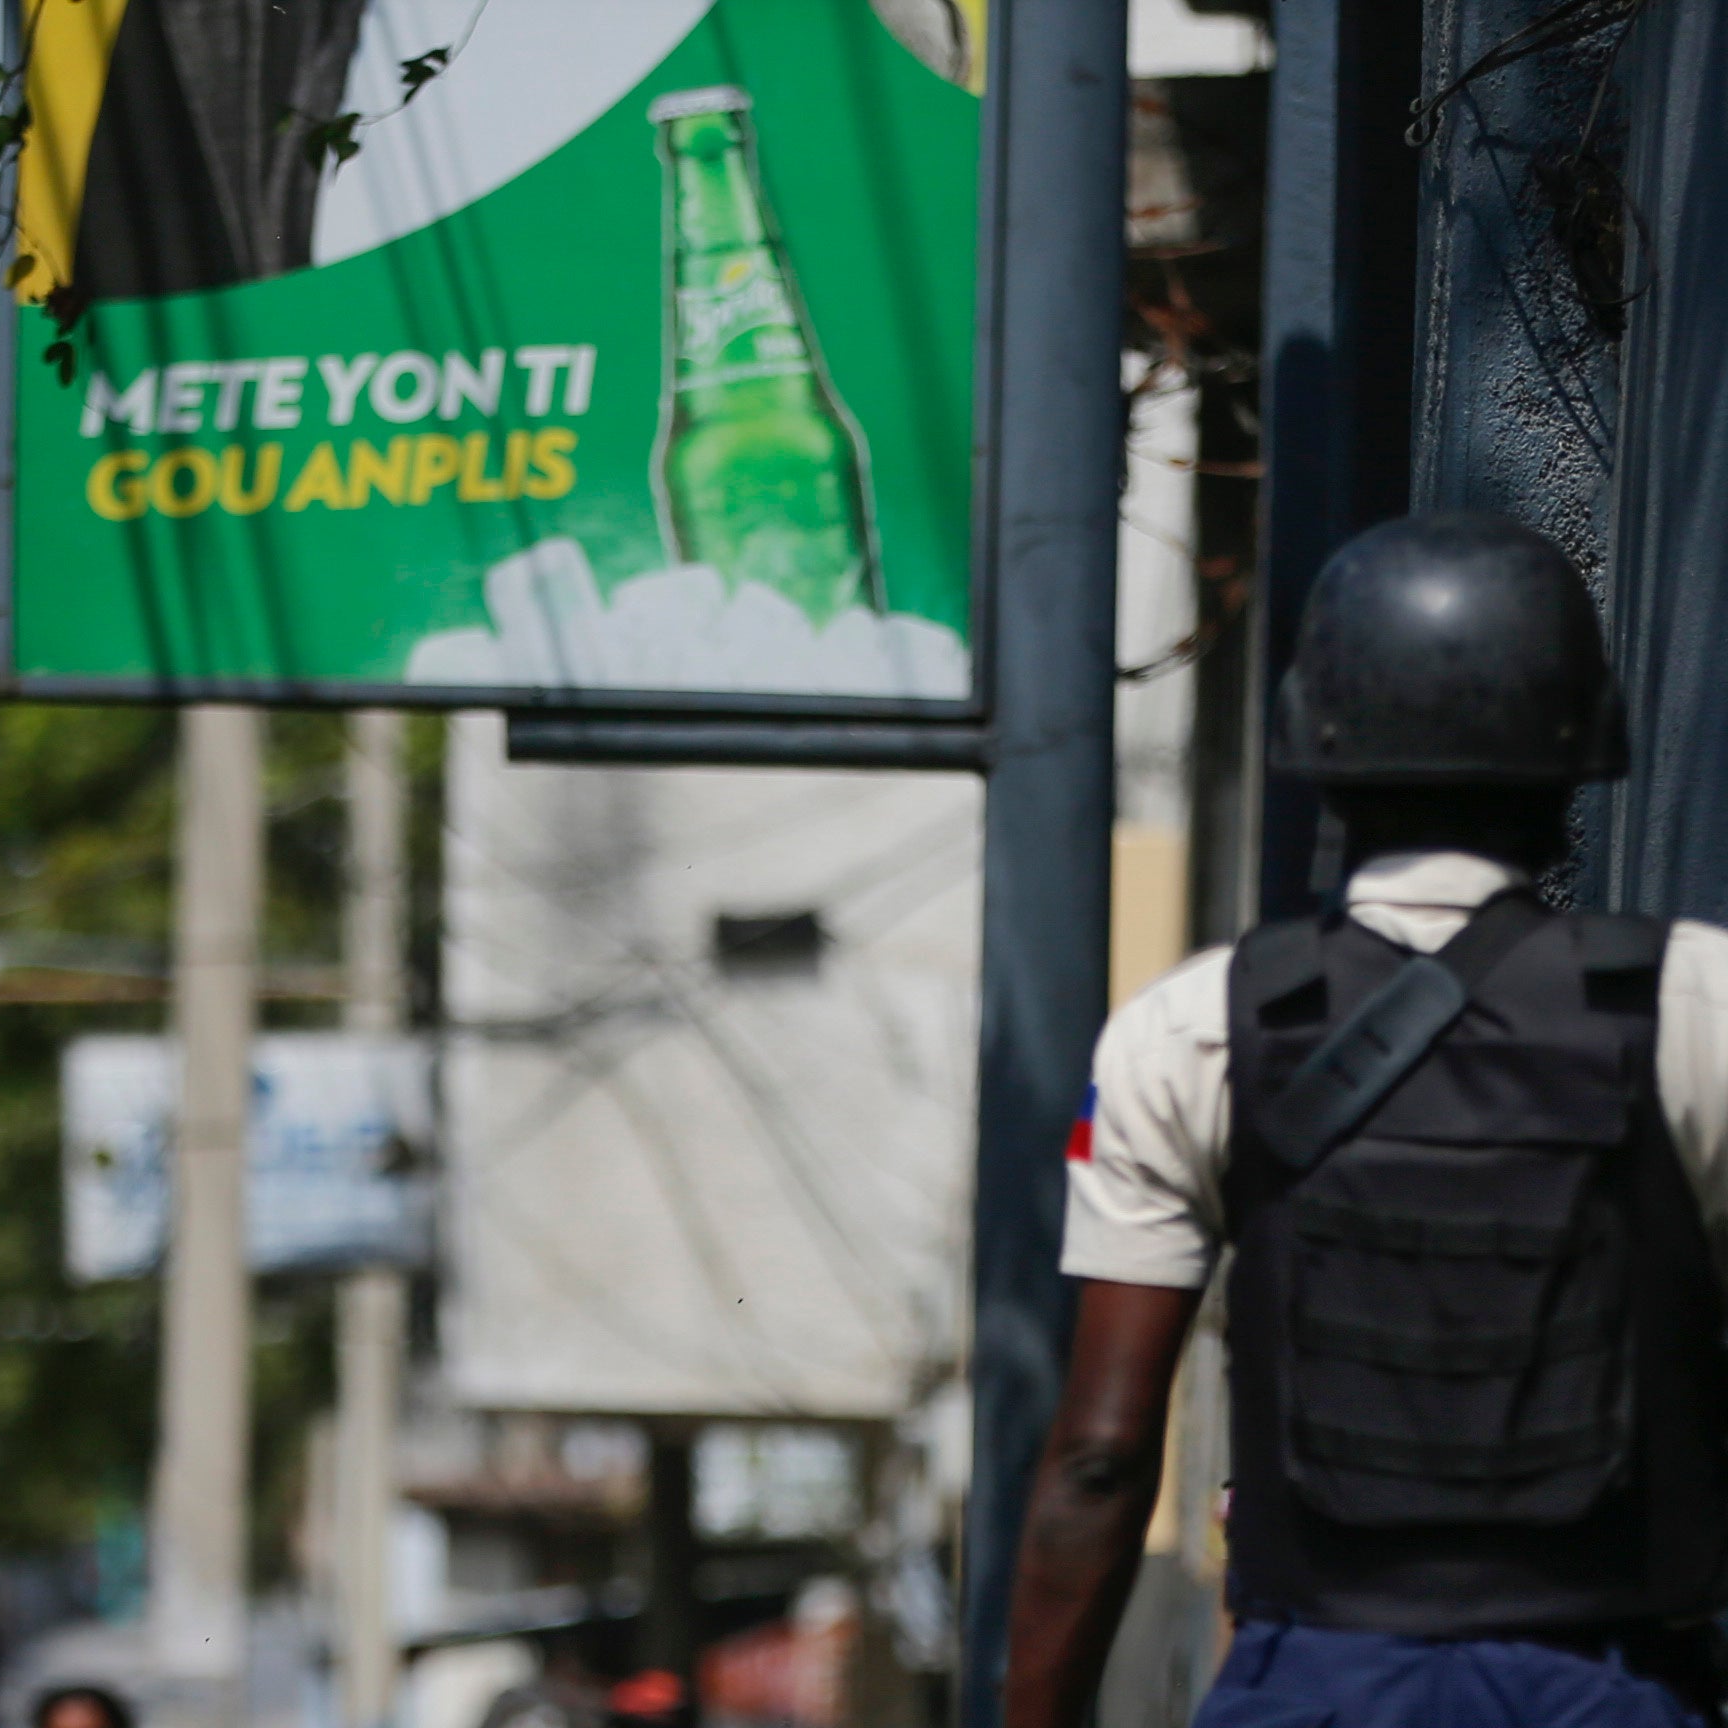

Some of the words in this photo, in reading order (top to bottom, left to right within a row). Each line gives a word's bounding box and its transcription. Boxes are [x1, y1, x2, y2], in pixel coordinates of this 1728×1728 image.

[78, 356, 309, 438] METE
[315, 347, 507, 426] YON
[514, 343, 597, 417] TI
[85, 441, 284, 521] GOU
[282, 426, 578, 512] ANPLIS
